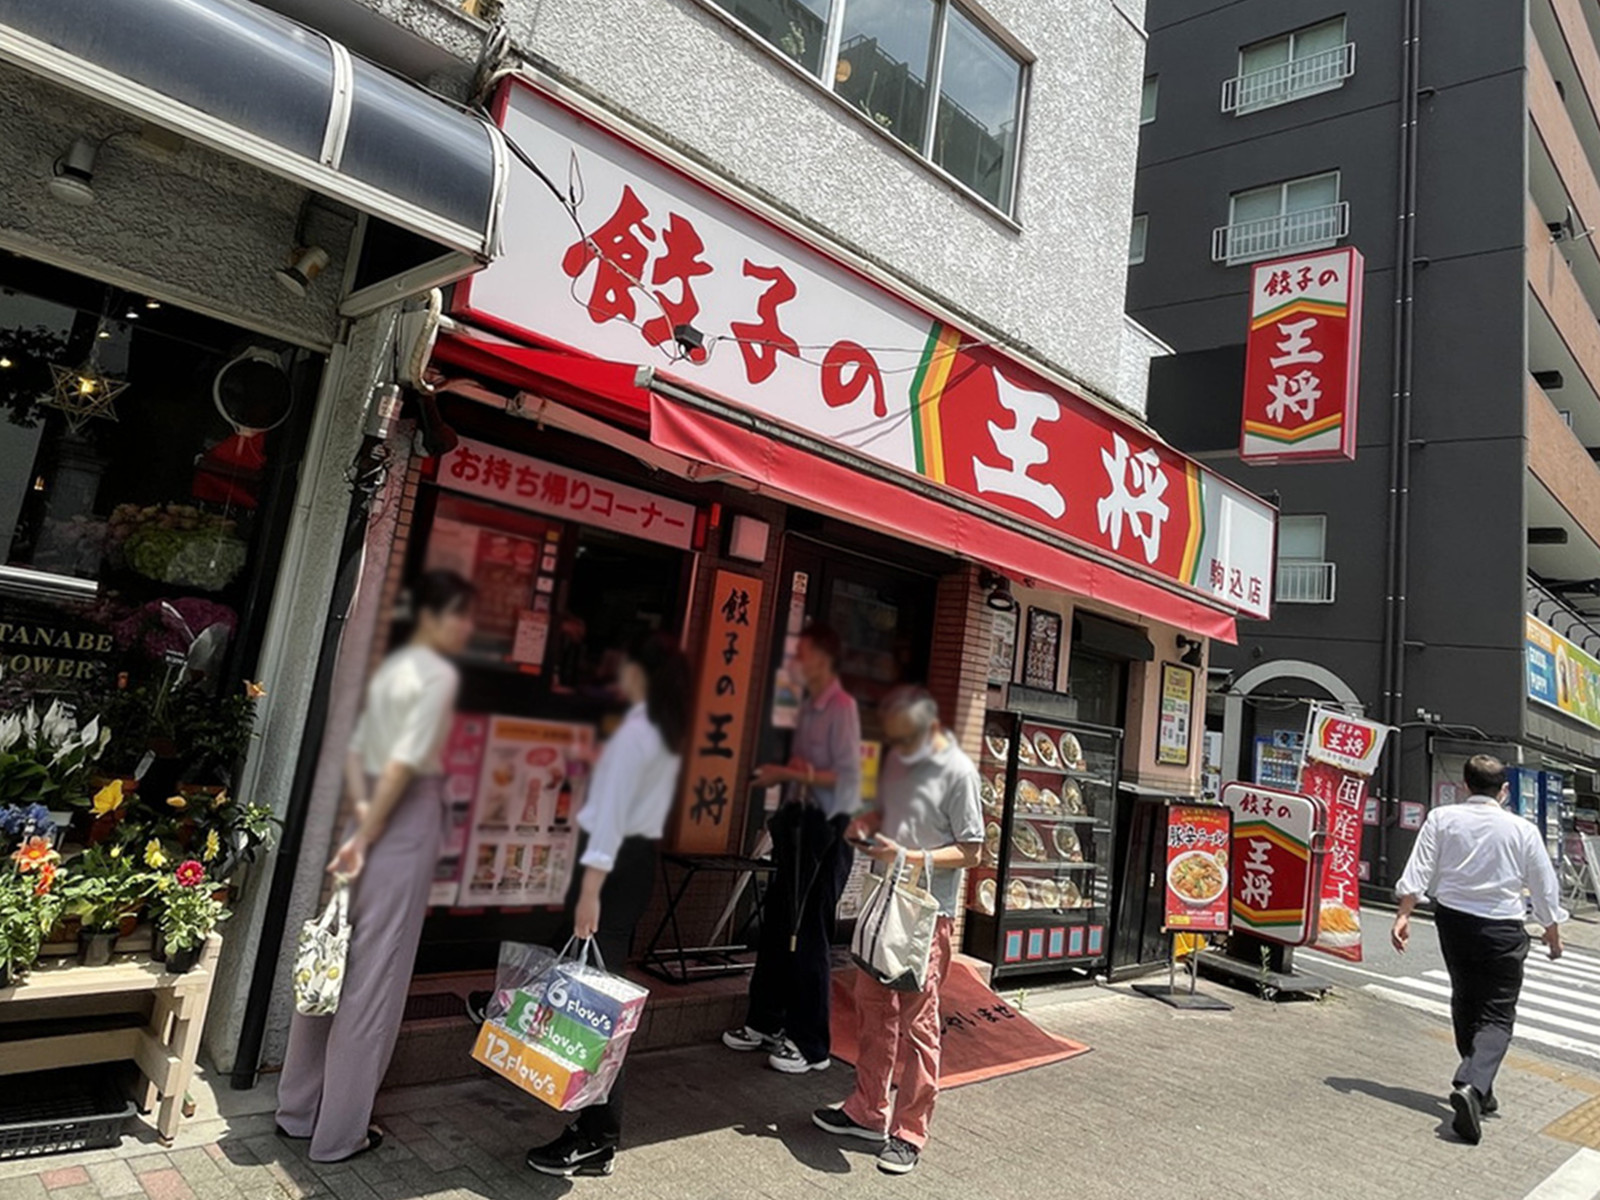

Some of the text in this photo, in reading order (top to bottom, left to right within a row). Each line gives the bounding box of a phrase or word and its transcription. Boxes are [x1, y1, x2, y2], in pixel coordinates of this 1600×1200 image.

[1263, 266, 1339, 297] 餃子の
[562, 184, 1171, 565] 餃子の 王将
[1265, 317, 1324, 423] 王将
[450, 446, 686, 530] お持ち帰りコーナー
[1210, 558, 1261, 606] 駒込店
[0, 654, 95, 679] OWER
[690, 587, 751, 827] 餃子の王将
[1326, 731, 1365, 757] 王将
[1239, 792, 1292, 818] 餃子の
[1324, 774, 1365, 905] 国産餃子
[1240, 838, 1275, 909] 王将
